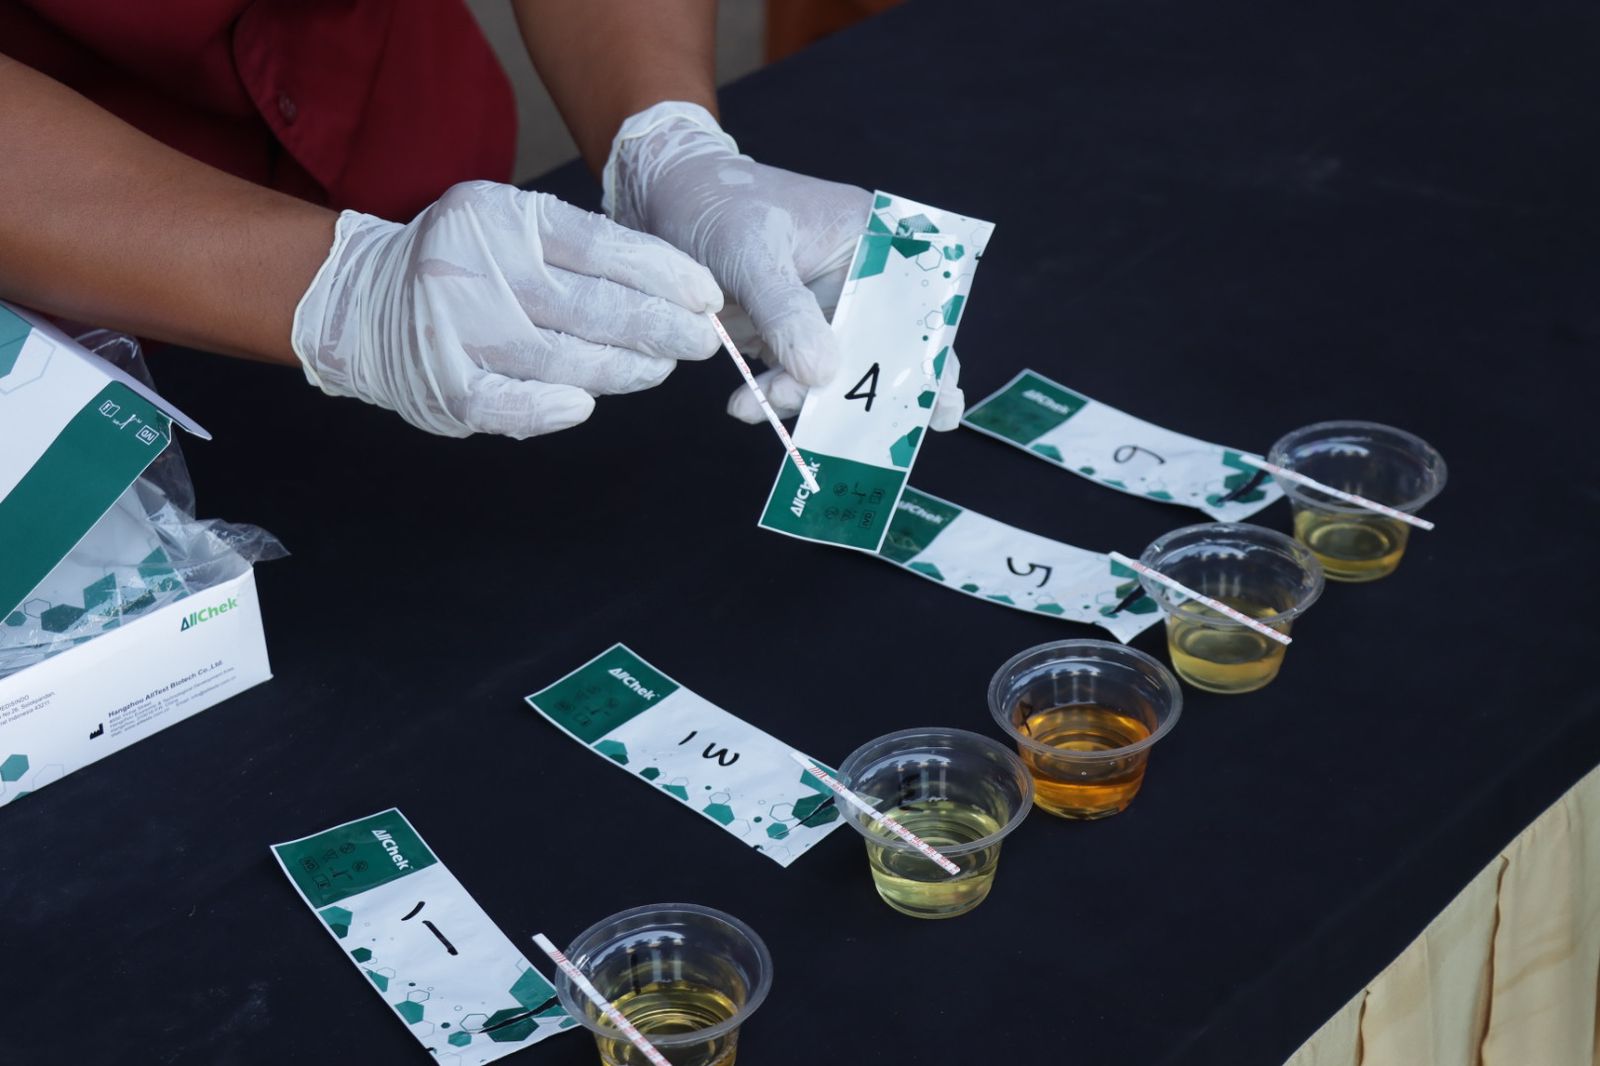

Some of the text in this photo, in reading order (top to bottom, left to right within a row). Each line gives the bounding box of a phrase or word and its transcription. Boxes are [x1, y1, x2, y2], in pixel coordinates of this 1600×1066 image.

[844, 362, 880, 412] 4
[1006, 556, 1053, 589] 5
[180, 598, 238, 632] AllChek
[108, 699, 144, 718] Hangzhou
[145, 685, 169, 701] AllTest
[170, 673, 197, 689] Biotech
[608, 667, 655, 701] AllChek
[371, 829, 408, 871] AllChek
